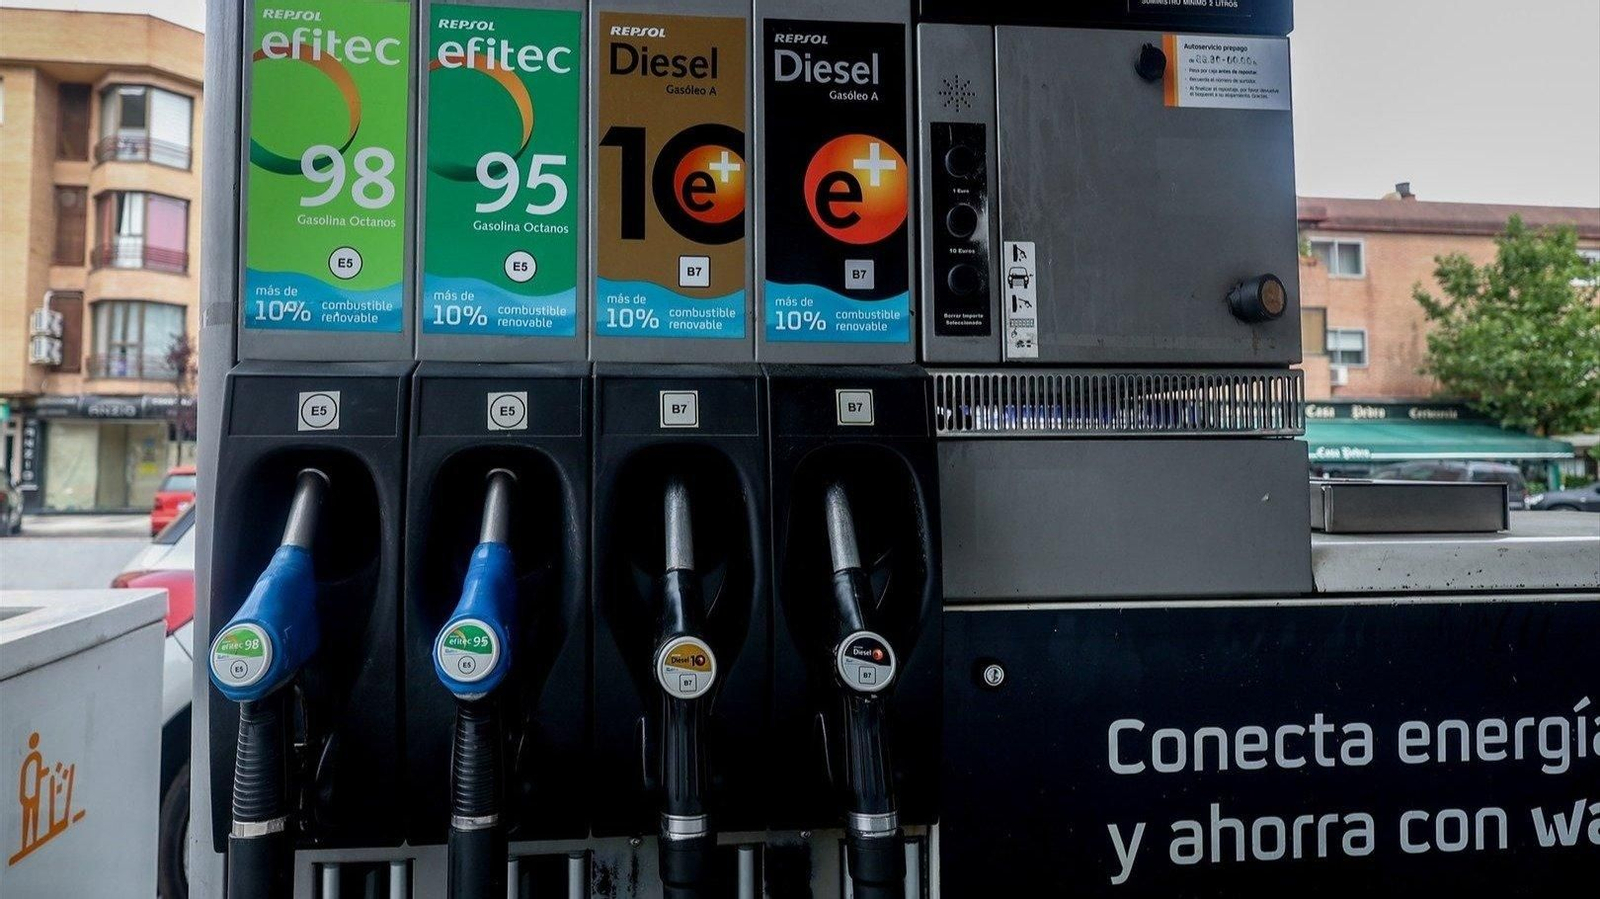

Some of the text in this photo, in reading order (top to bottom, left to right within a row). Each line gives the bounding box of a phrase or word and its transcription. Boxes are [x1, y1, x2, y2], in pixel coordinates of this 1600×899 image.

[262, 8, 322, 22] REPSOL
[438, 18, 496, 32] REPSOL
[610, 26, 666, 38] REPSOL
[774, 34, 828, 45] REPSOL
[261, 27, 400, 66] efitec
[1223, 45, 1248, 53] prepago
[437, 36, 572, 74] efitec
[610, 42, 718, 79] Diesel
[774, 49, 879, 85] Diesel
[666, 84, 717, 96] Gasóleo A
[828, 90, 879, 102] Gasóleo A
[299, 144, 396, 209] 98
[474, 151, 568, 216] 95
[600, 123, 746, 245] 10
[297, 213, 396, 228] Gasolina Octanos
[473, 220, 569, 235] Gasolina Octanos
[337, 258, 353, 268] E5
[512, 261, 528, 272] E5
[686, 266, 702, 277] B7
[852, 270, 866, 280] B7
[255, 285, 298, 296] más de
[434, 290, 474, 301] más de
[606, 294, 646, 304] más de
[775, 297, 814, 306] más de
[255, 300, 393, 322] 10% combustible
[433, 304, 566, 326] 10% combustible
[498, 316, 553, 328] renovable
[606, 308, 736, 329] 10% combustible
[668, 318, 722, 330] renovable
[775, 310, 901, 332] 10% combustible
[836, 321, 888, 332] renovable
[310, 405, 327, 416] E5
[499, 405, 516, 416] E5
[672, 404, 688, 414] B7
[848, 402, 863, 412] B7
[245, 638, 260, 650] 98
[473, 636, 488, 647] 95
[672, 654, 705, 666] Diesel 10
[1108, 696, 1600, 775] Conecta energí
[1107, 822, 1146, 886] y
[1170, 804, 1376, 864] ahorra
[1400, 807, 1508, 854] con
